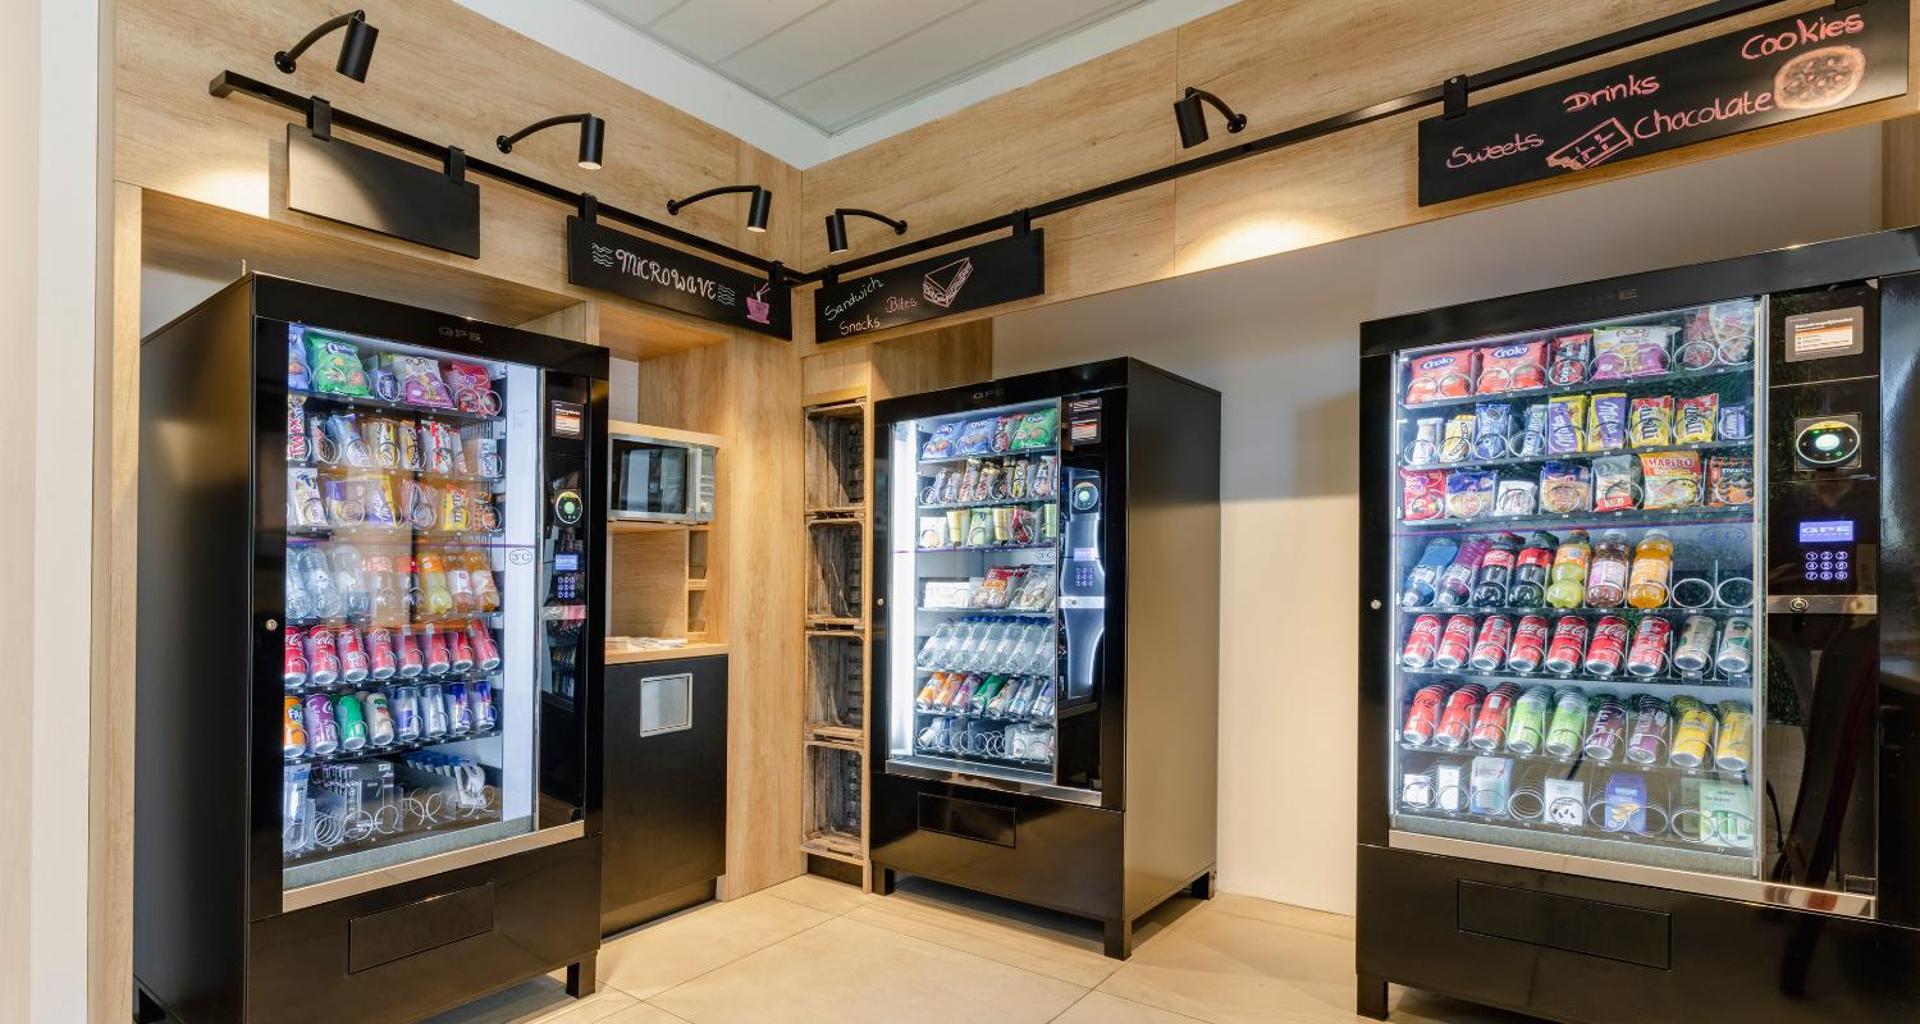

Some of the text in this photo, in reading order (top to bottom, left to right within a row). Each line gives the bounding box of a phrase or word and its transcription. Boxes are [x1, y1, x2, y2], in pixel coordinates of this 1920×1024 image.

[1741, 13, 1865, 61] Cookies
[1562, 74, 1660, 113] Drinks
[1633, 90, 1774, 141] Chocolate
[1445, 132, 1545, 170] Sweets
[824, 276, 884, 322] Sandwich
[885, 295, 918, 314] Bites
[839, 314, 881, 336] Snacks
[1423, 357, 1455, 369] Croky
[1494, 345, 1528, 358] Croky
[1650, 458, 1694, 472] HARIBO
